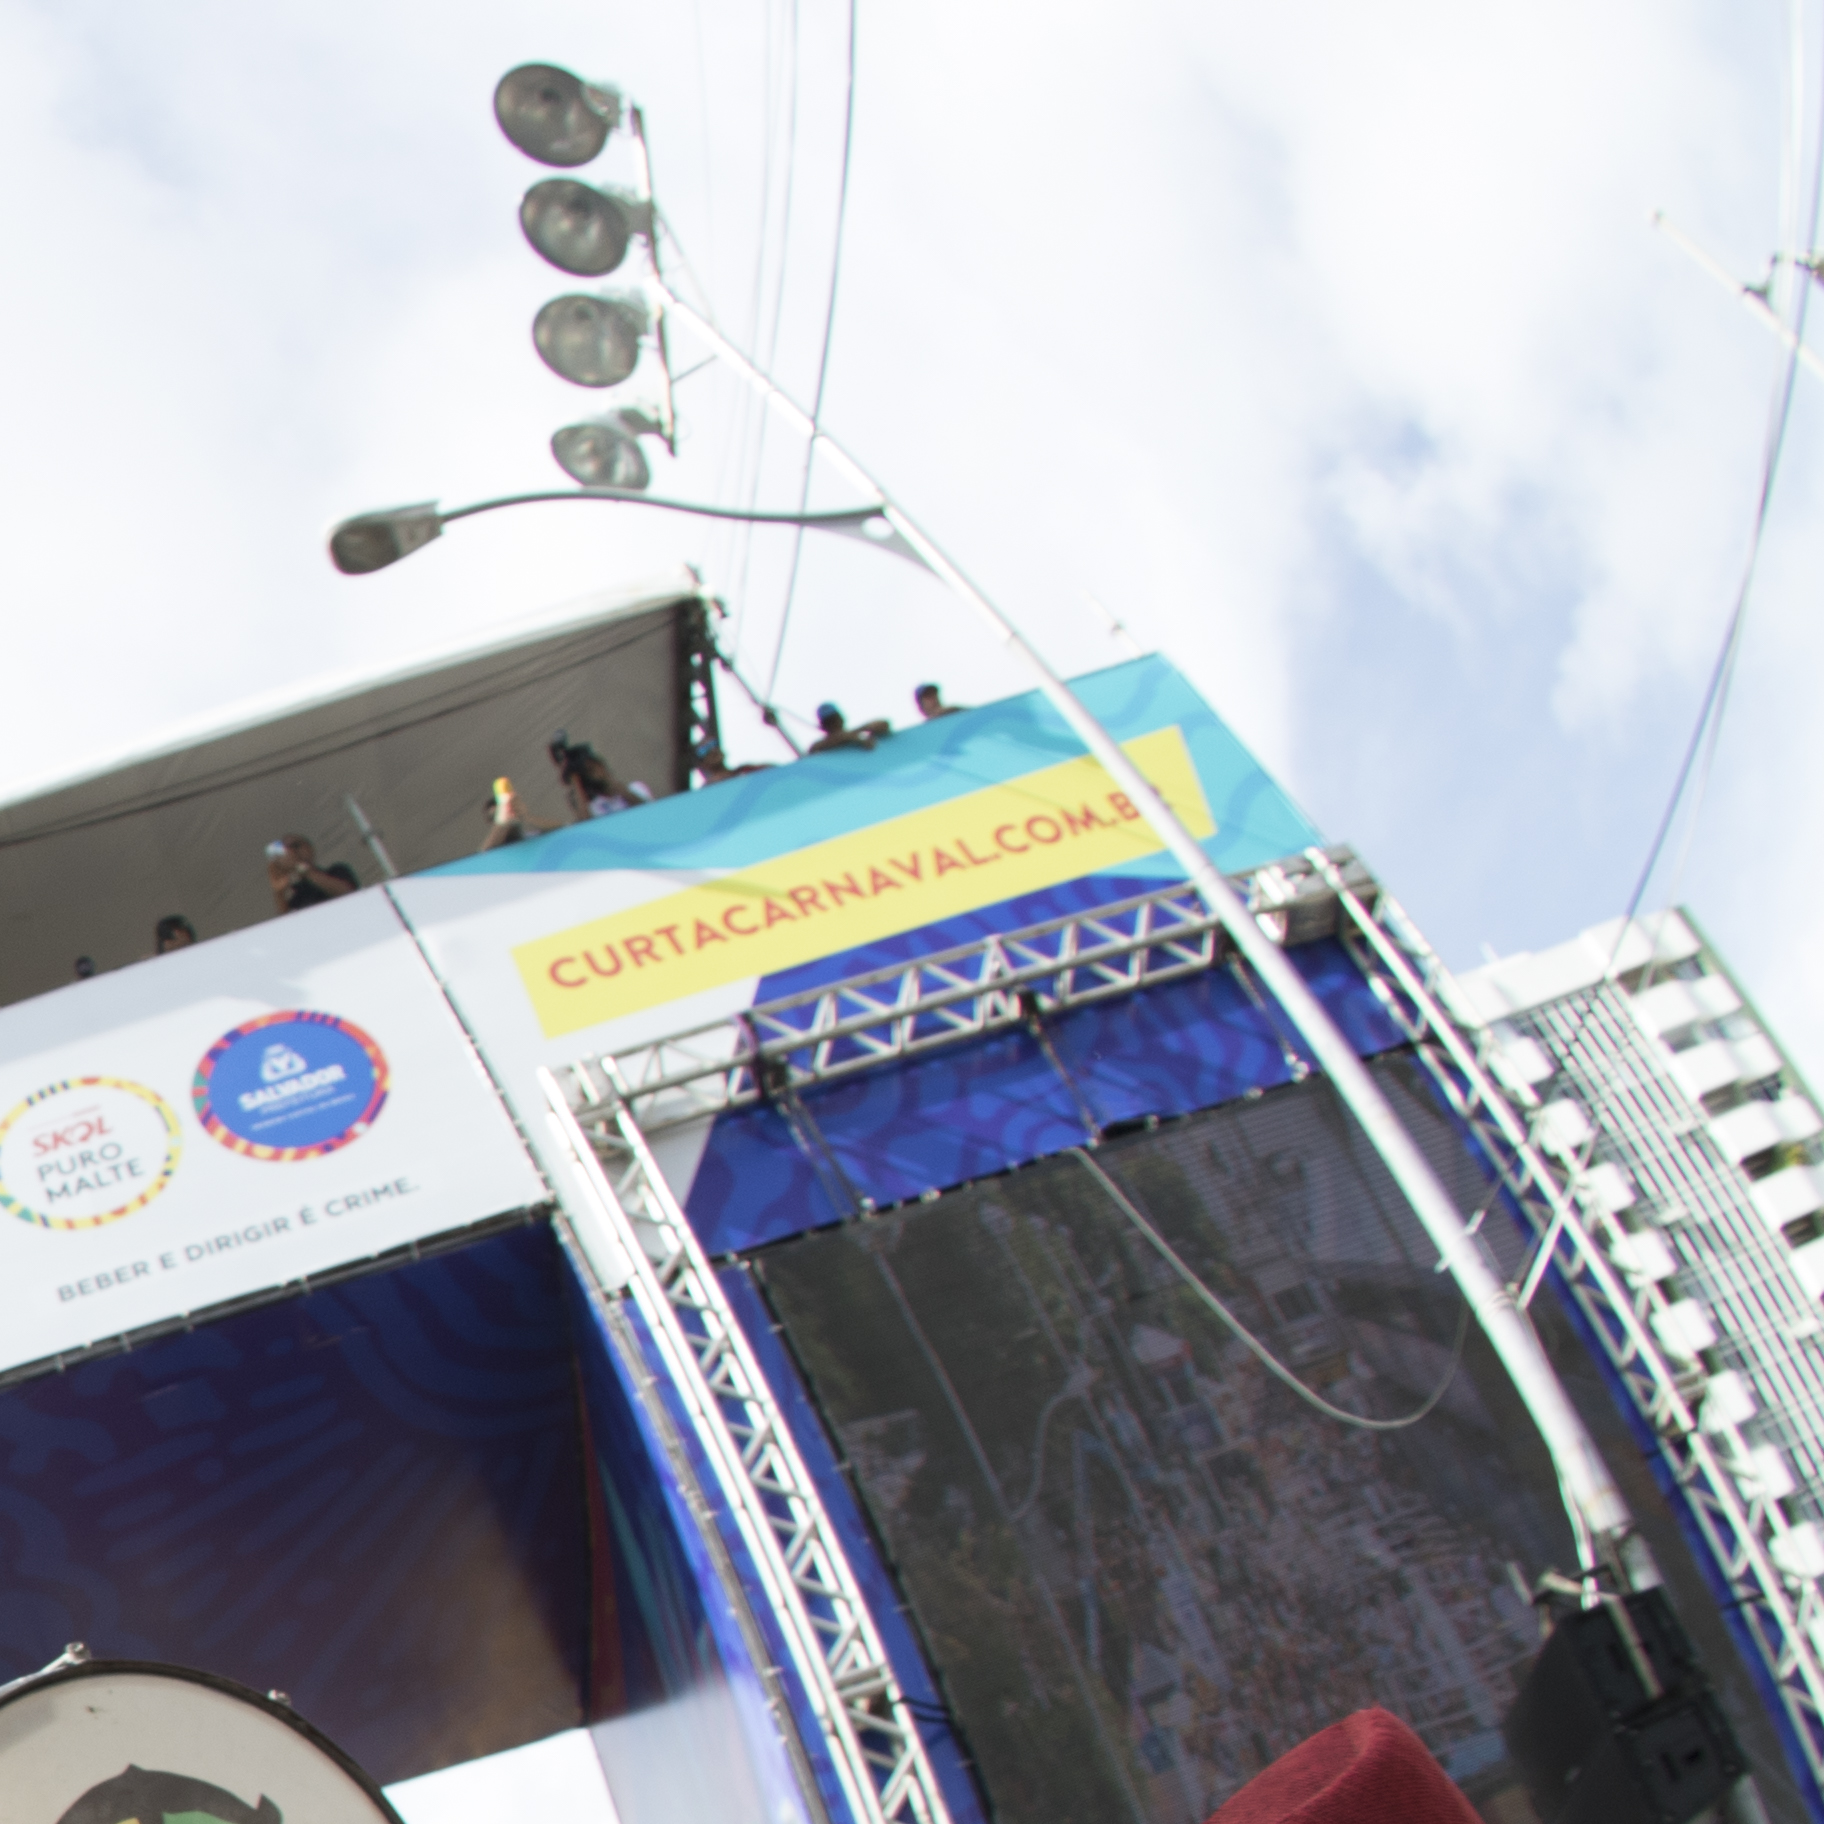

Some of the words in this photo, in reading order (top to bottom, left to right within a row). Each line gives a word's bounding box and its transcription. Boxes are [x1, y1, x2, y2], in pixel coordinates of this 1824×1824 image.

[549, 784, 1174, 990] CURTACARNAVAL.COM.B
[32, 1115, 113, 1158] SKOL
[38, 1141, 124, 1182] PURO
[45, 1156, 145, 1205] MALTE
[56, 1258, 152, 1304] BEBER
[159, 1249, 180, 1274] E
[185, 1216, 291, 1263] DIRIGIR
[297, 1202, 317, 1230] É
